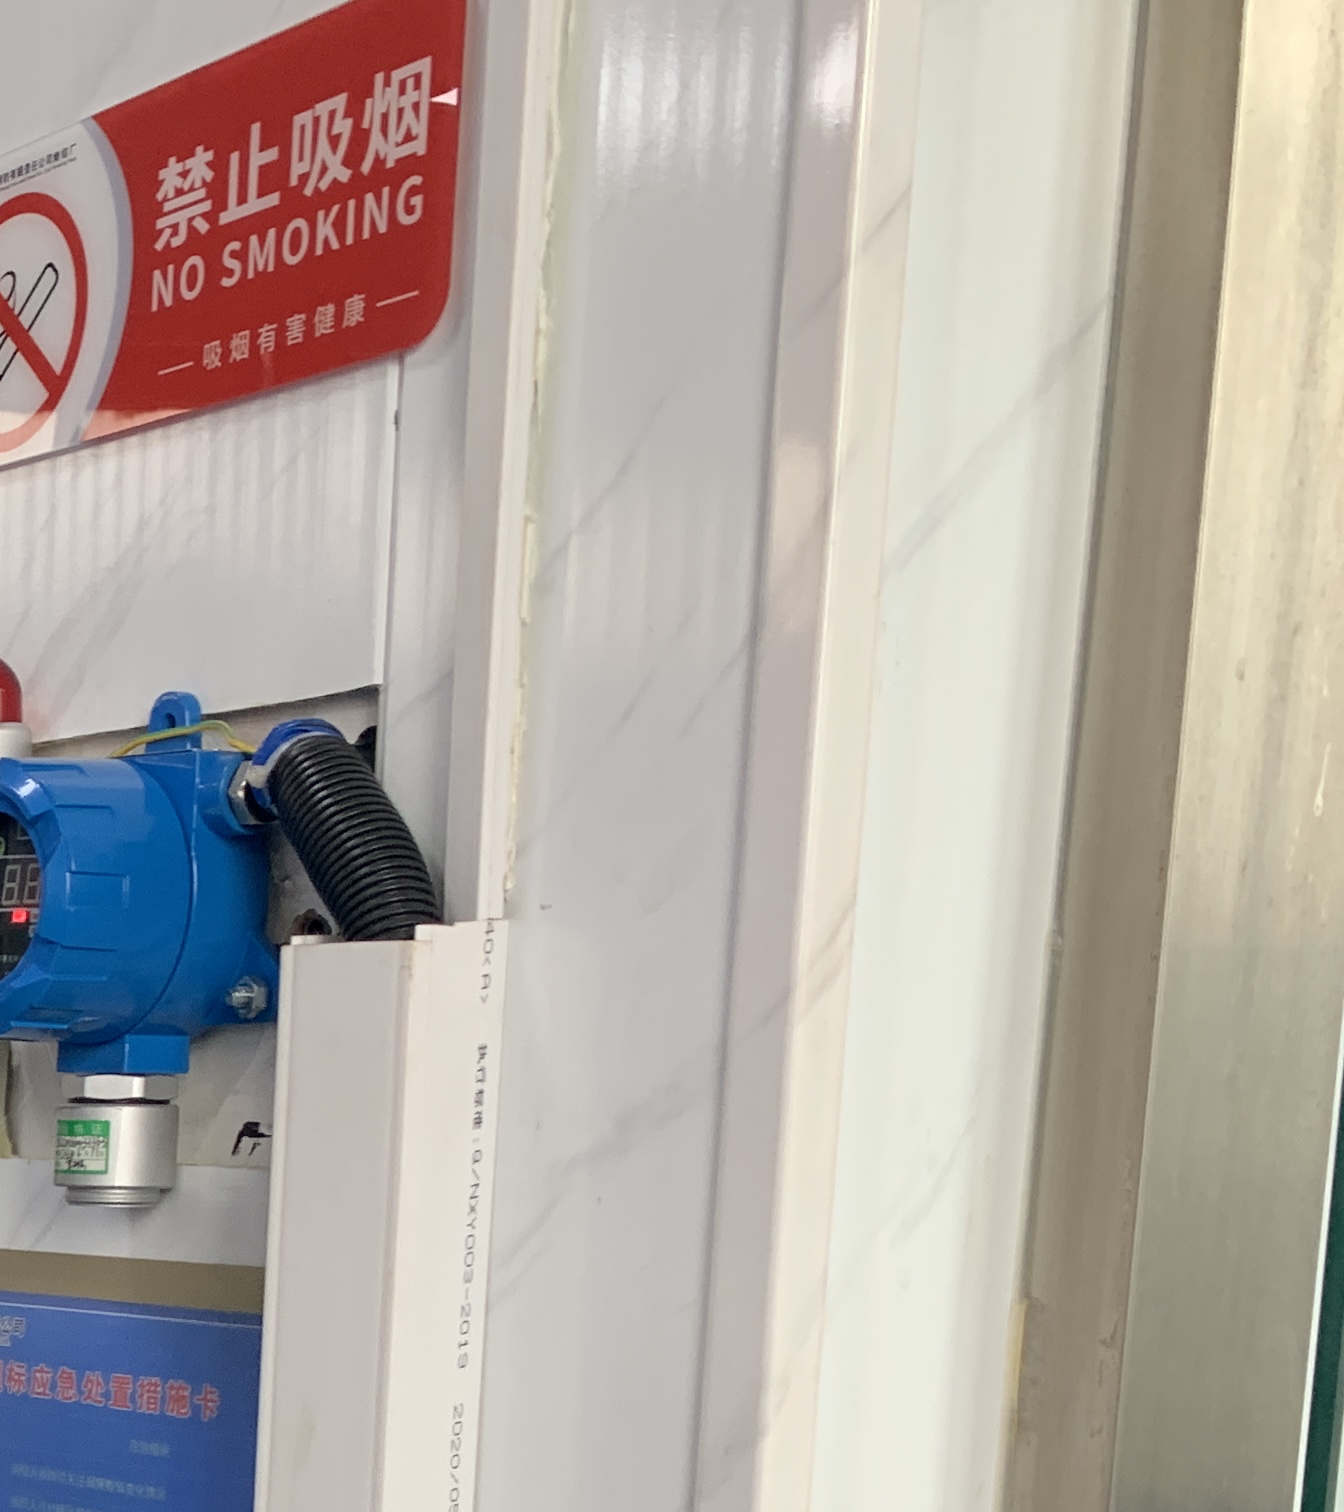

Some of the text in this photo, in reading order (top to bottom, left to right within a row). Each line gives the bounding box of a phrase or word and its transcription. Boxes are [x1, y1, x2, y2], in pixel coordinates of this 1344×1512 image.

[151, 56, 434, 252] 禁止吸烟
[150, 175, 426, 312] NO SMOKING
[202, 293, 366, 371] 吸烟有害健康
